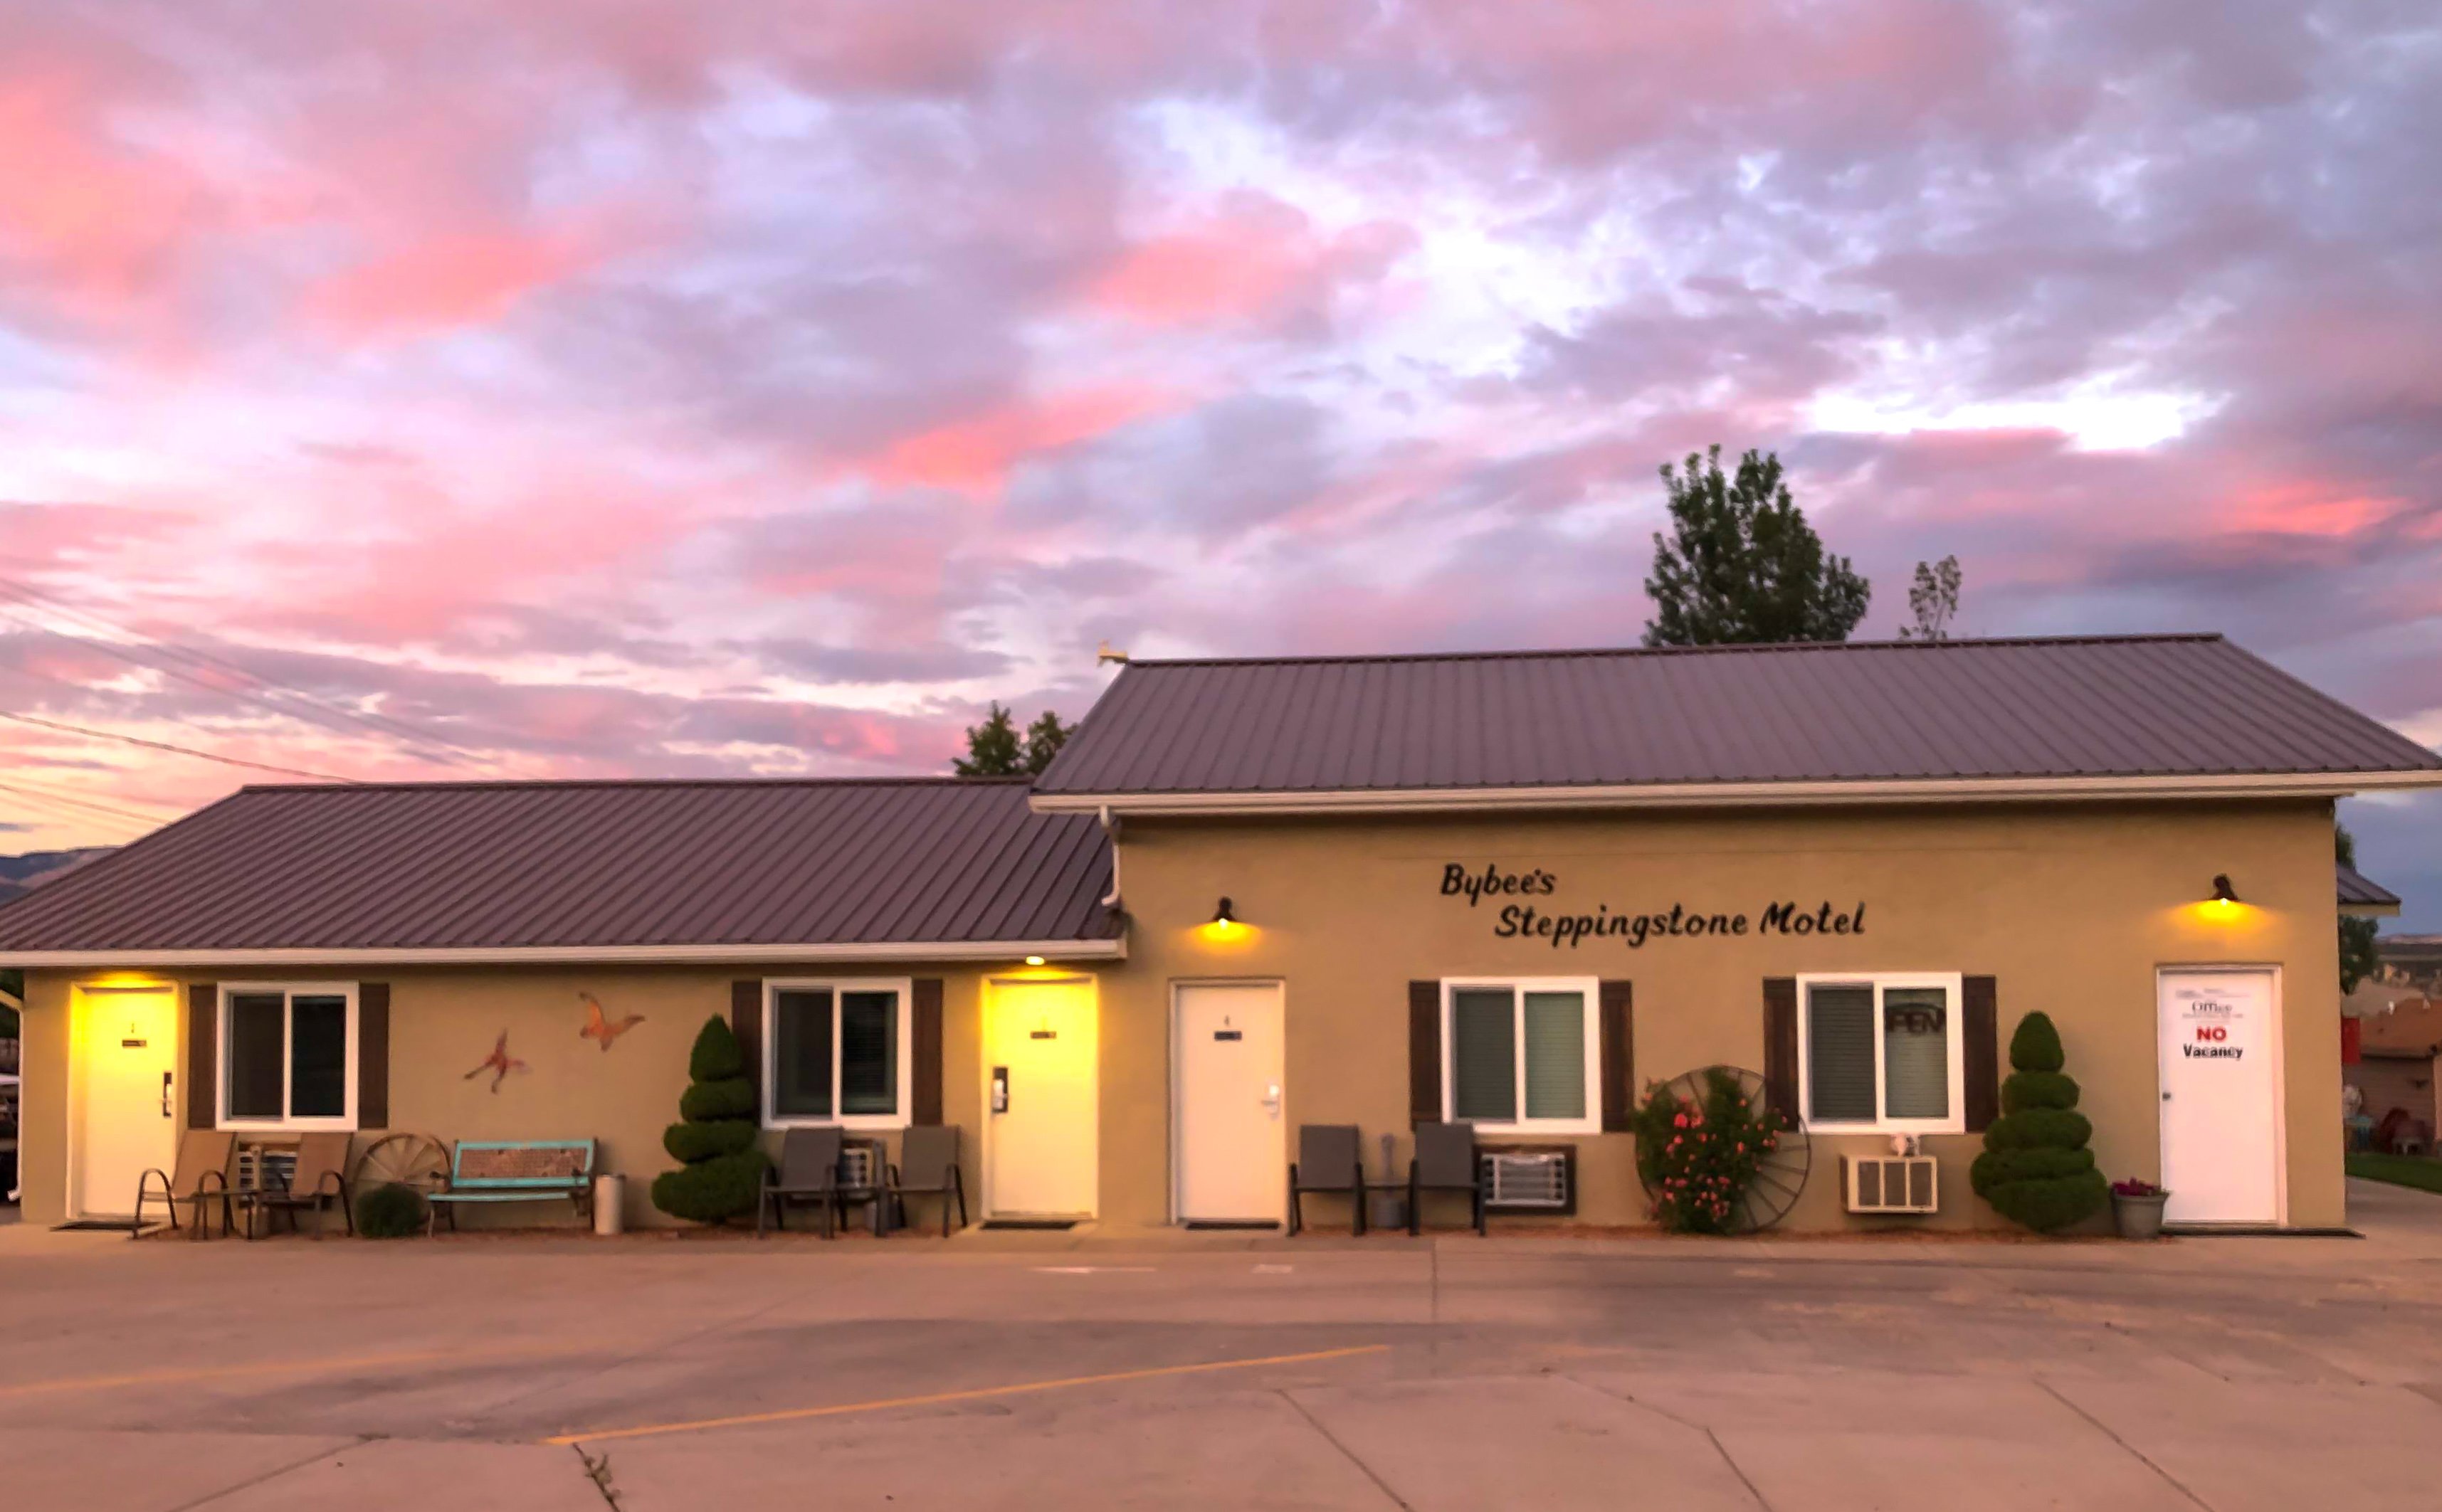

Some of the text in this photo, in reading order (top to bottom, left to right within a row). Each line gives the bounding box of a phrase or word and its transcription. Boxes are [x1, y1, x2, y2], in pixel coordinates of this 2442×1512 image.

[1441, 863, 1557, 906] Bybee's
[1495, 901, 1865, 948] Steppingstone Motel
[2196, 1027, 2227, 1042] NO
[2183, 1044, 2243, 1060] Vacancy
